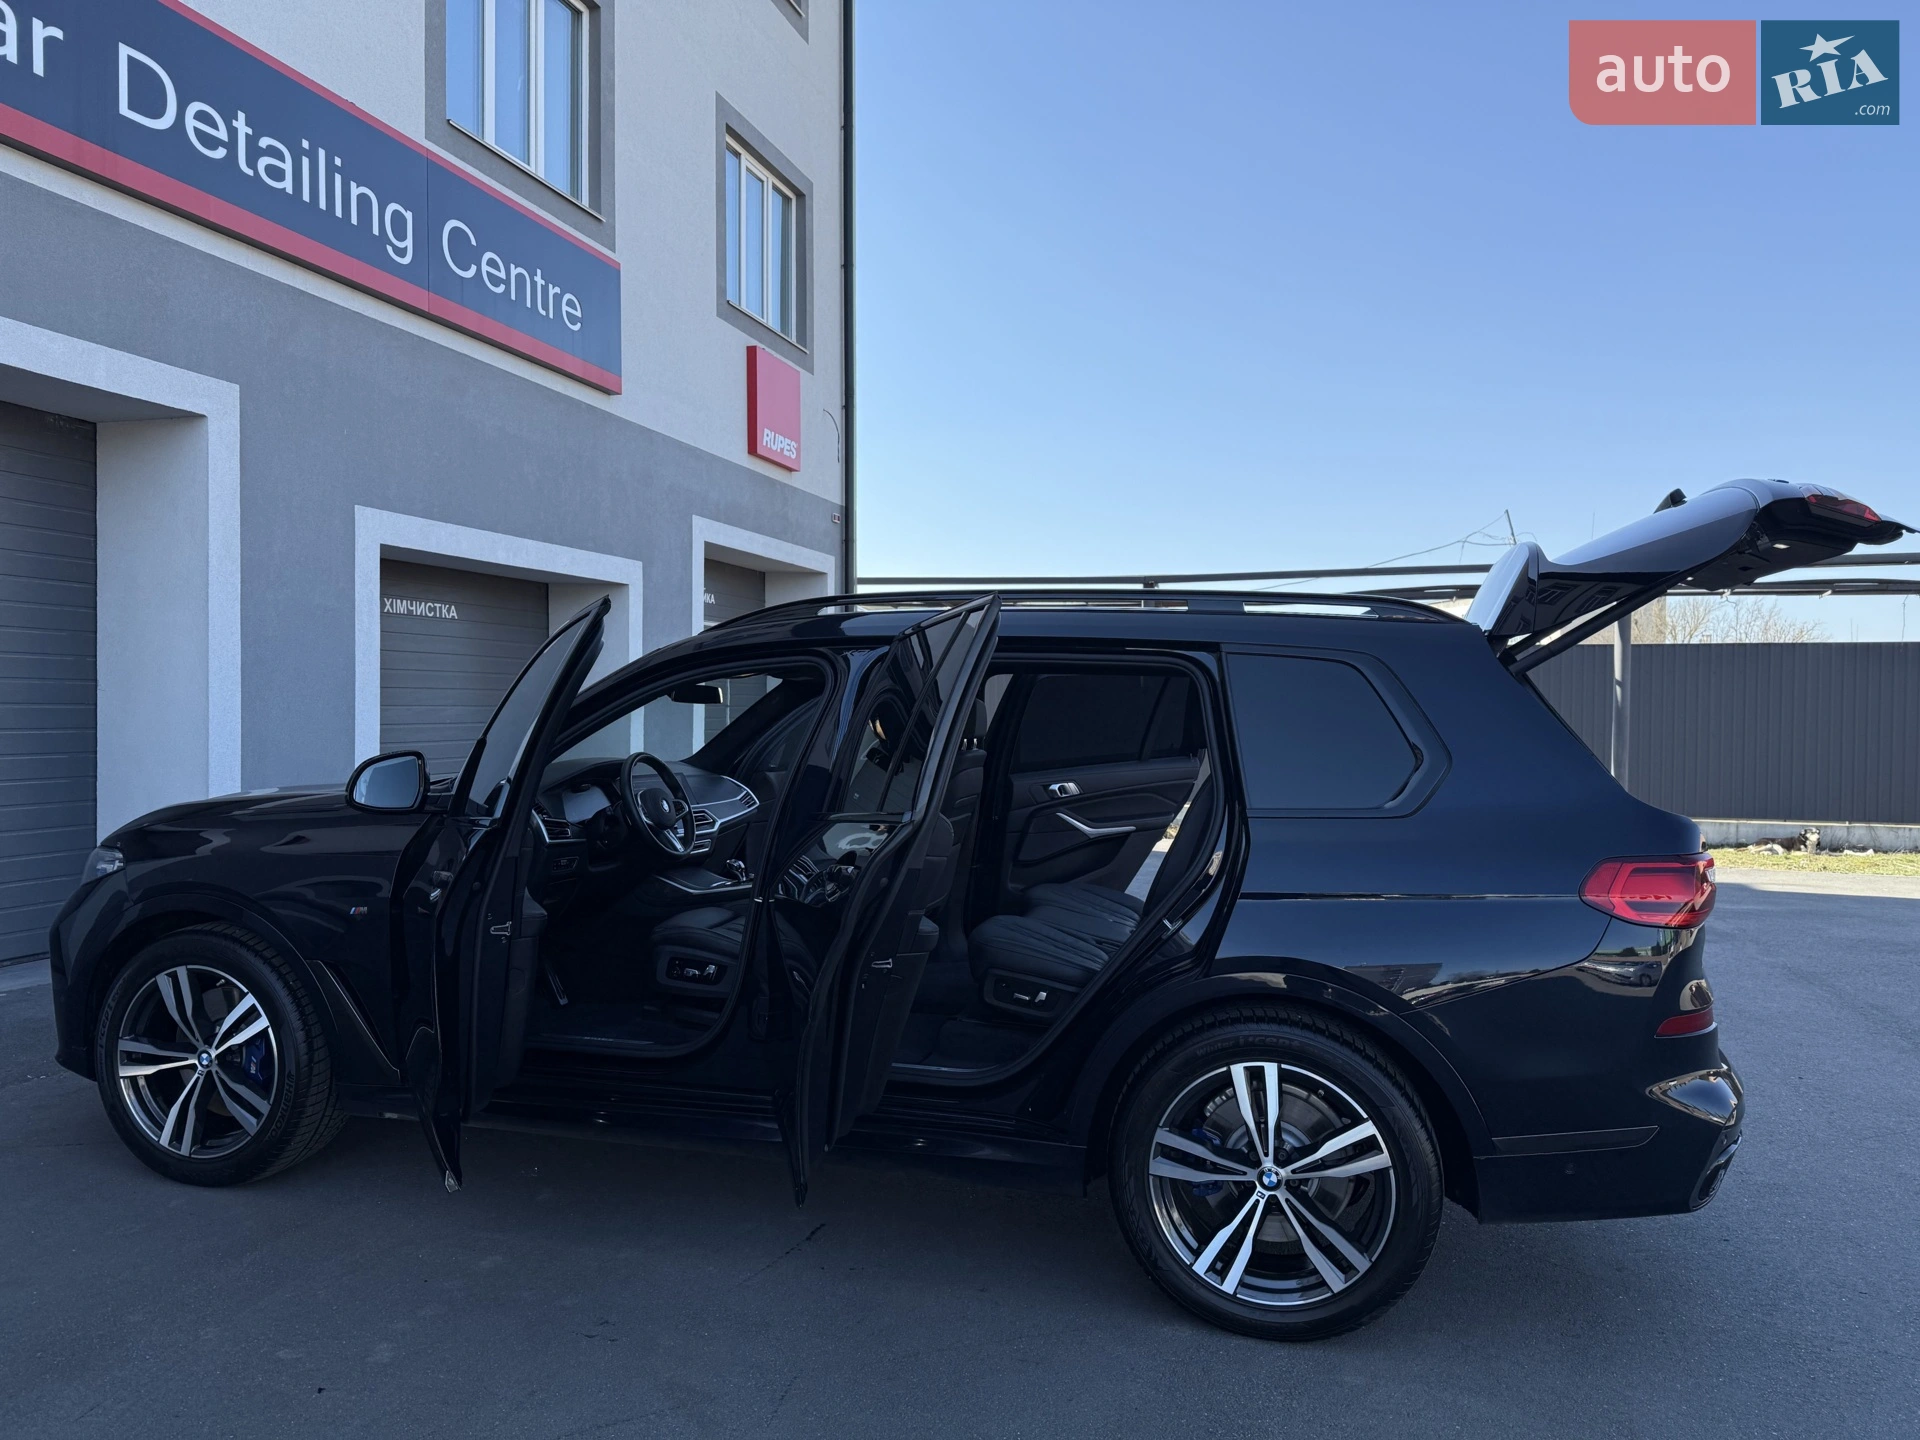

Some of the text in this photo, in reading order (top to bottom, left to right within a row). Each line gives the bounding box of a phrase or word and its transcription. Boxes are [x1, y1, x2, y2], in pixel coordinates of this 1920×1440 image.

[118, 42, 414, 265] Detailing
[442, 219, 584, 332] Centre
[762, 427, 797, 459] RUPES
[383, 597, 458, 619] ХІМЧИСТКА
